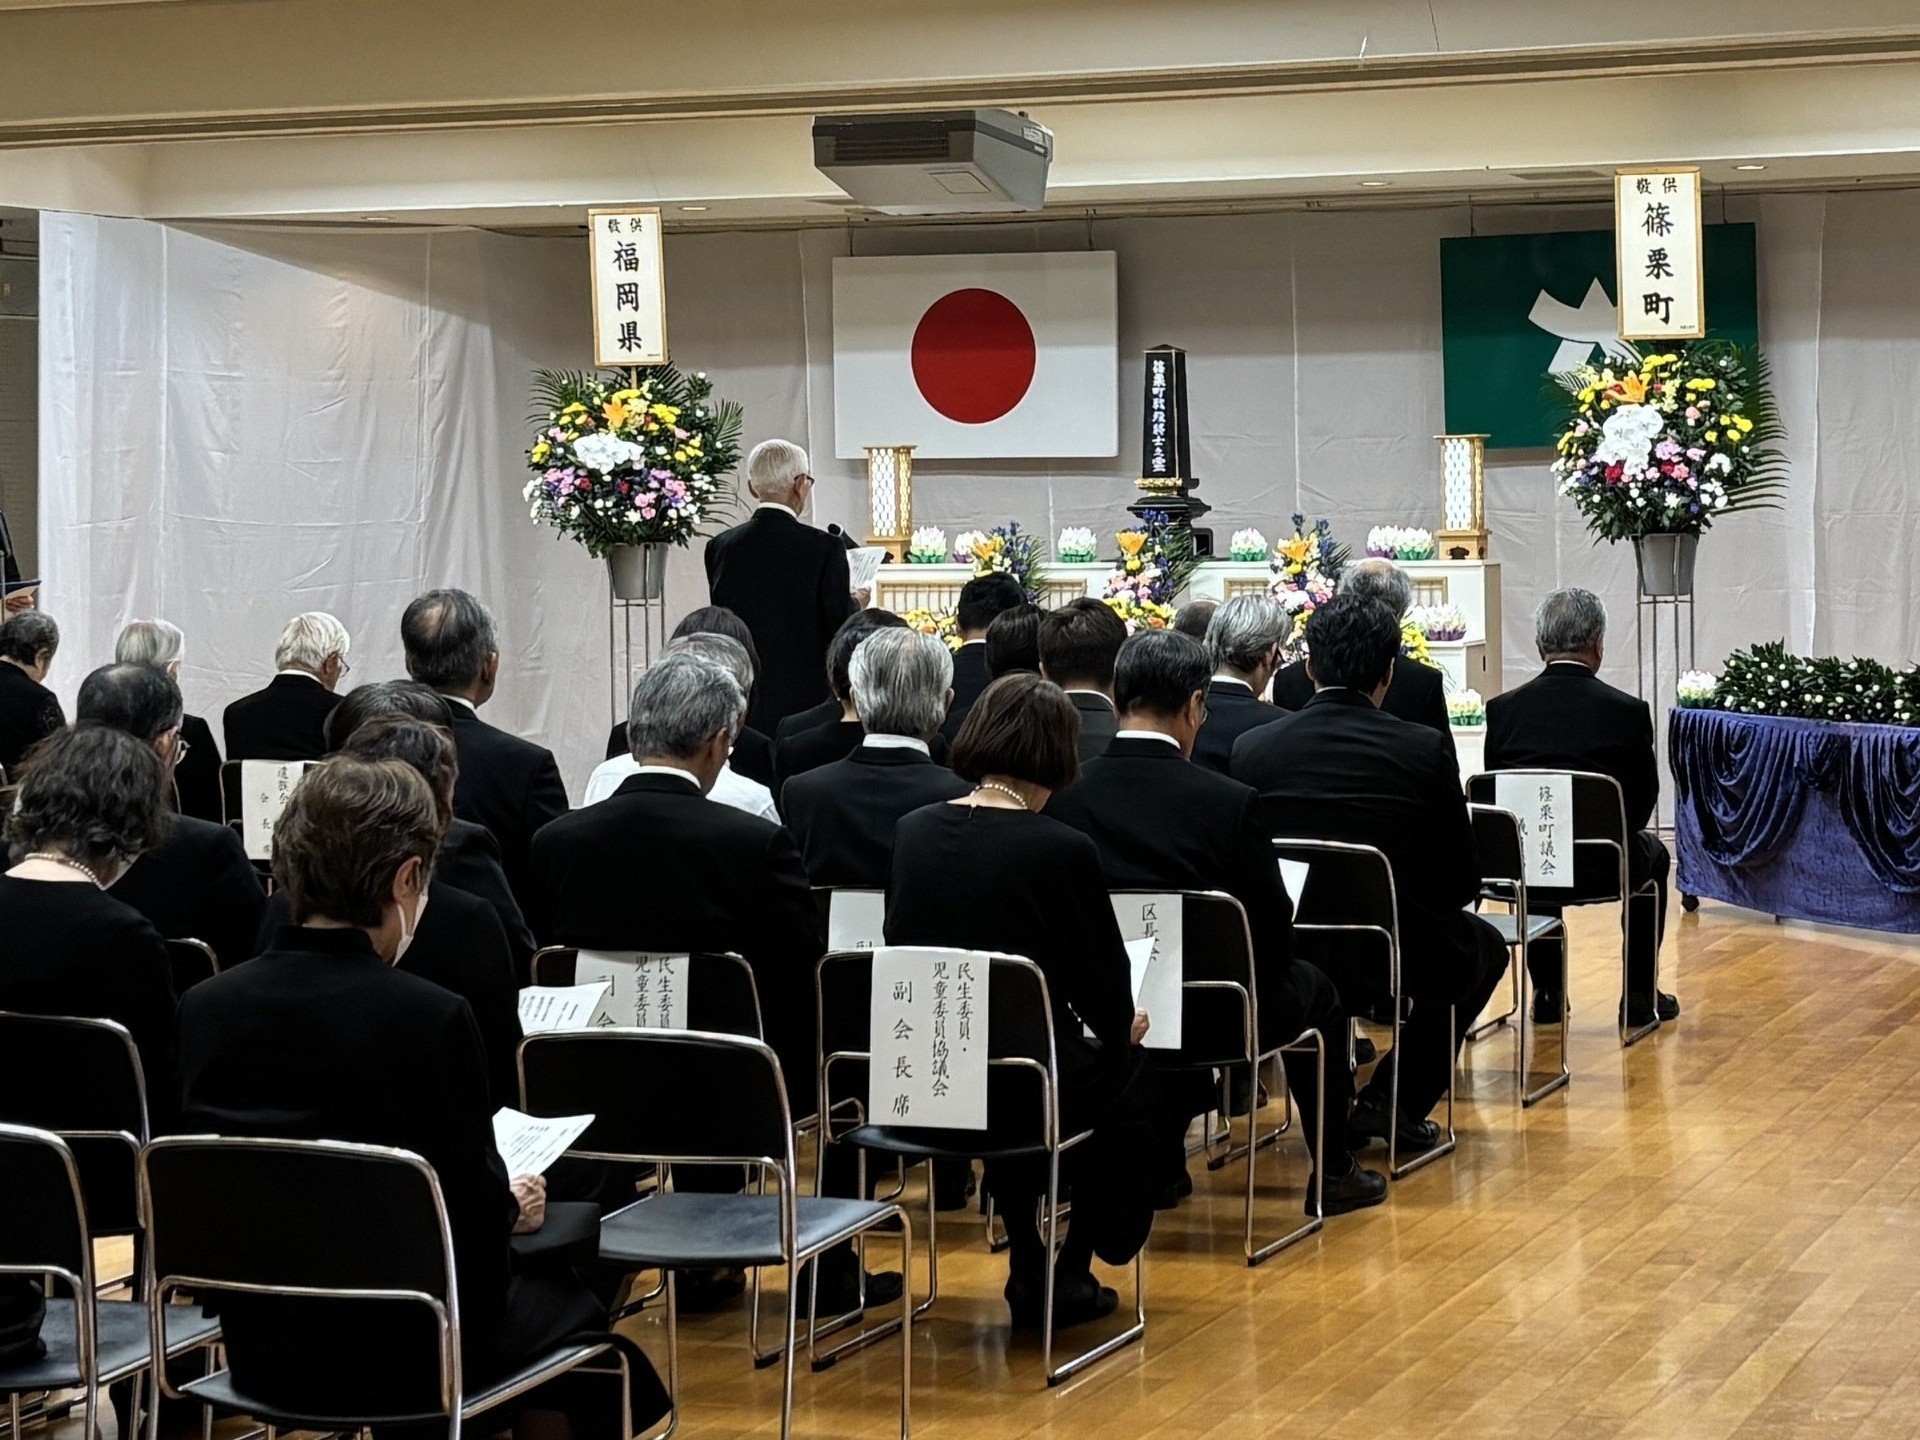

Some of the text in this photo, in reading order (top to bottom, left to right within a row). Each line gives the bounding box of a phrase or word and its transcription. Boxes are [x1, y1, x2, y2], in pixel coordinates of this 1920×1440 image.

[612, 241, 642, 353] 福岡県
[1641, 202, 1674, 325] 篠栗町
[1538, 785, 1556, 876] 篠栗町議会
[892, 981, 914, 1118] 副会長席
[931, 961, 950, 1098] 児童委員協議会
